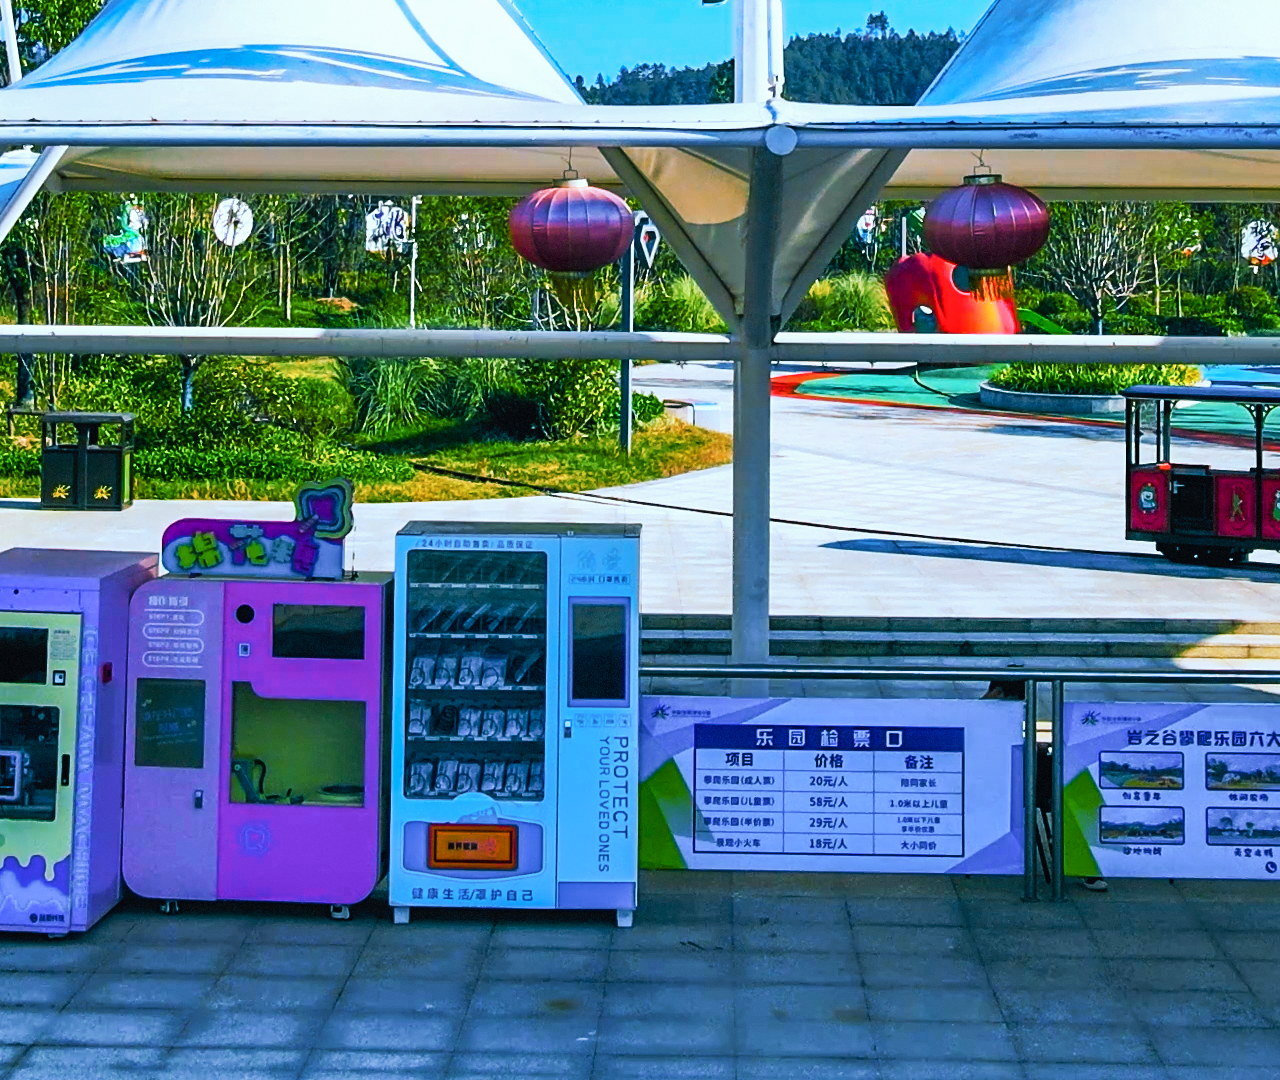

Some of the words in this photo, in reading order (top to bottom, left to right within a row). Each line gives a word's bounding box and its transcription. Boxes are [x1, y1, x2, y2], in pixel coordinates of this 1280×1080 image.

[755, 728, 903, 748] 乐园检票口
[598, 736, 611, 776] YOUR
[725, 752, 754, 767] 项目
[814, 753, 844, 768] 价格
[904, 755, 934, 770] 备注
[612, 736, 629, 840] PROTECT
[809, 775, 849, 788] 20元/人
[598, 780, 611, 830] LOVED
[809, 796, 849, 809] 58元/人
[809, 817, 849, 830] 29元/人
[597, 833, 611, 873] ONES
[809, 838, 848, 851] 18元/人
